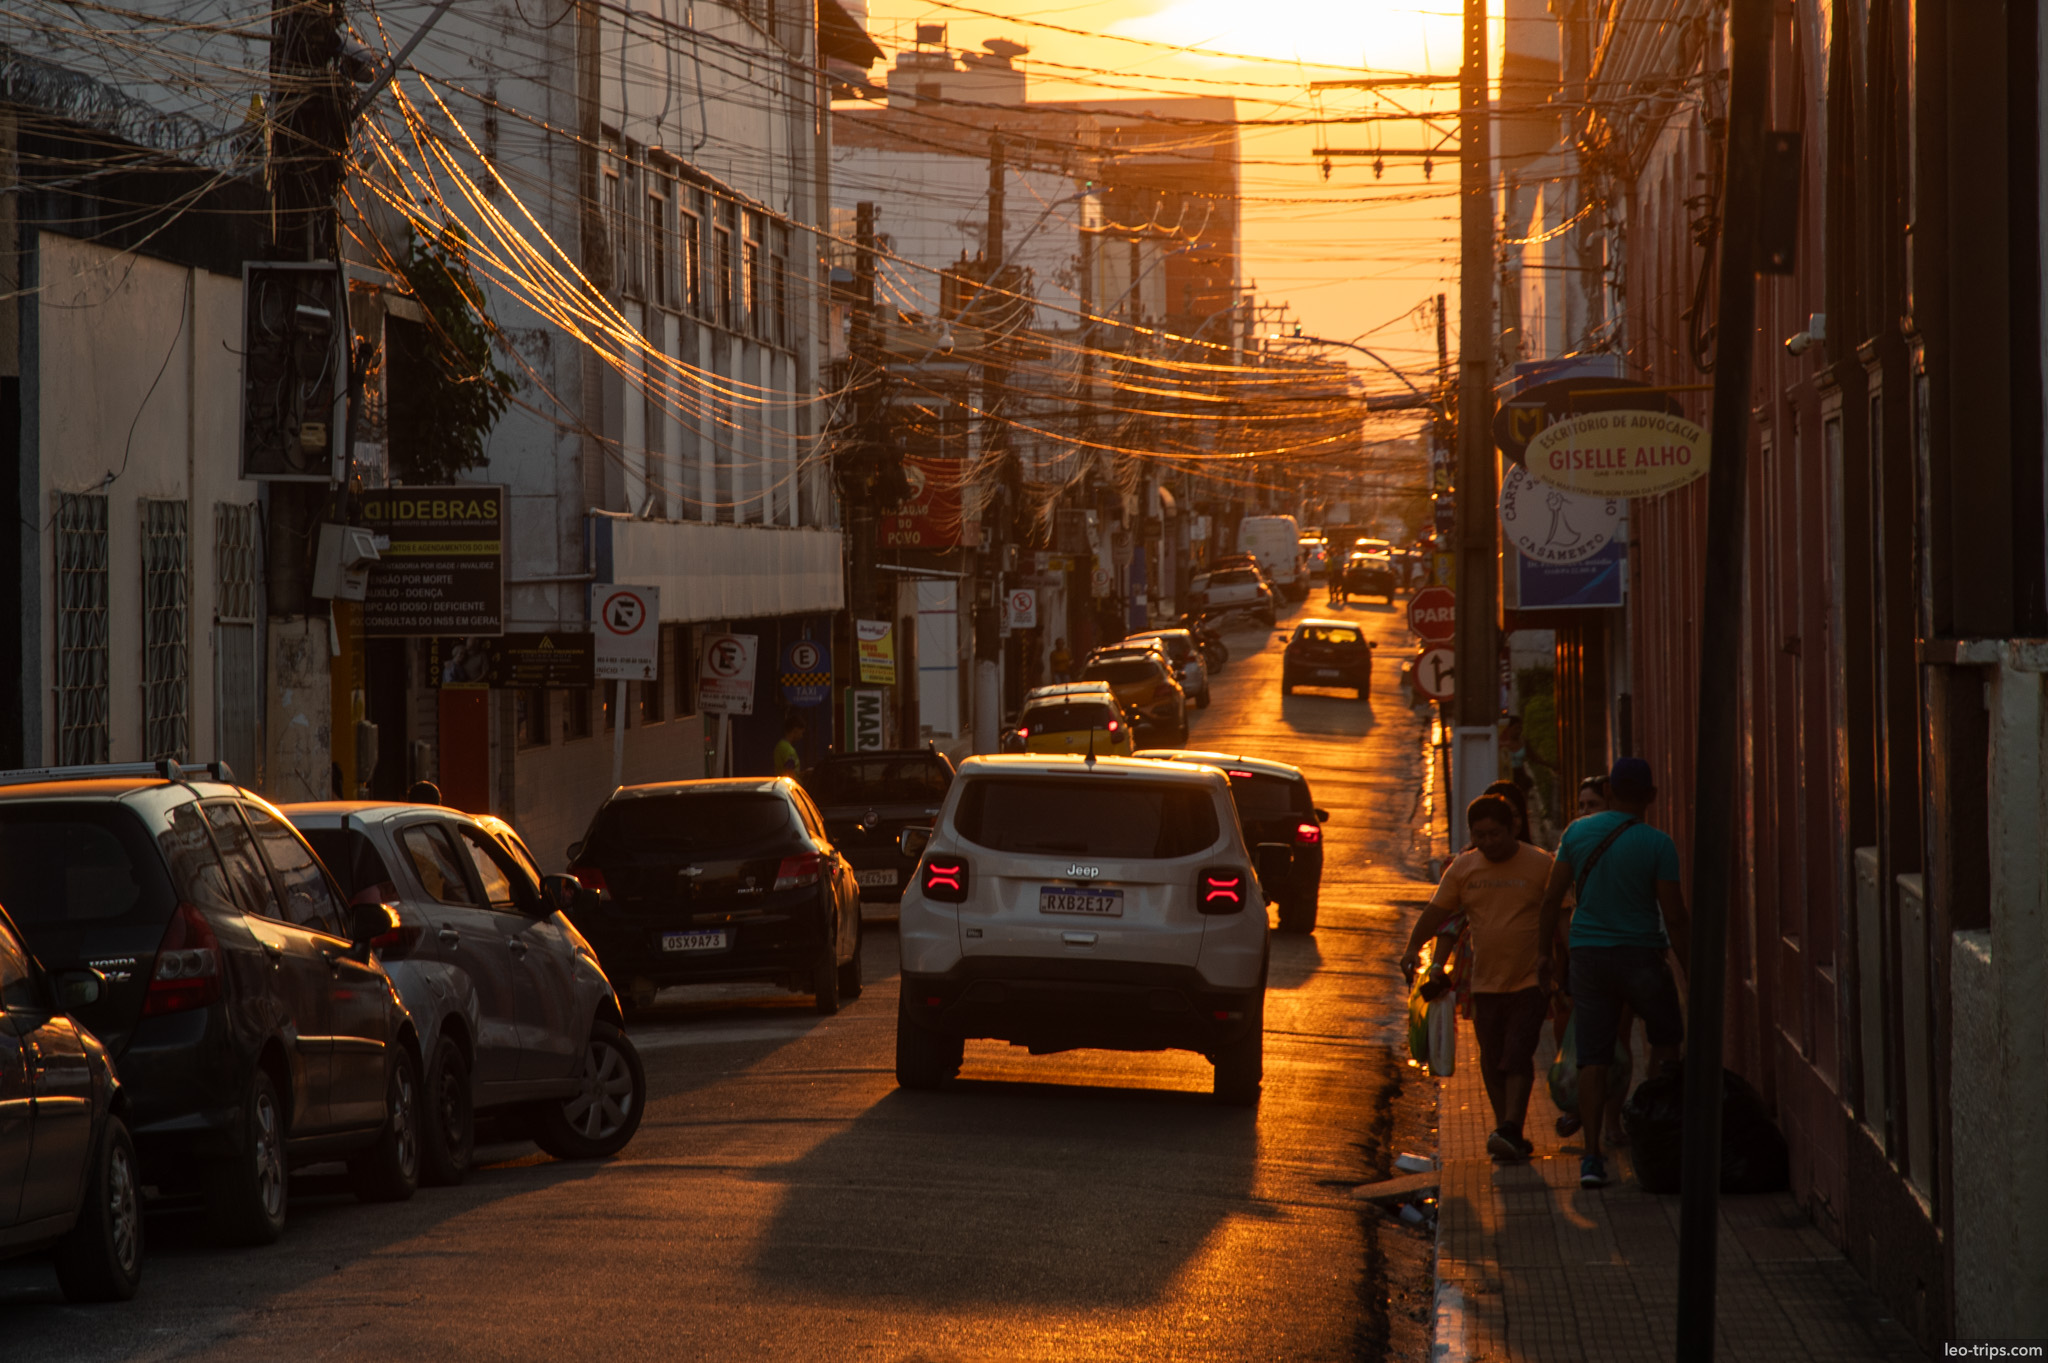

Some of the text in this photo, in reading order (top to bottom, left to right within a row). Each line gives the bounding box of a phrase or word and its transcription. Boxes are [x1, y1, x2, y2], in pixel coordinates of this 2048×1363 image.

[1613, 417, 1627, 429] DE
[1631, 416, 1700, 444] ADVOCACIA
[1549, 445, 1692, 470] GISELLE ALHO
[888, 531, 921, 545] POVO
[418, 543, 472, 552] AGENDAMENTOS
[473, 543, 483, 551] DO
[1519, 533, 1605, 561] CASAMENTO
[420, 562, 435, 570] POR
[402, 575, 421, 584] POR
[423, 574, 454, 584] MORTE
[406, 587, 443, 599] DOENÇA
[384, 602, 398, 611] AO
[399, 602, 428, 611] IDOSO
[434, 601, 485, 612] DEFICIENTE
[365, 615, 500, 626] CONSULTAS DO INSS EM GERAL
[799, 649, 809, 665] E
[796, 686, 817, 696] TAXI
[1067, 863, 1099, 878] Jeep
[1047, 895, 1114, 912] RXB2E17
[668, 935, 720, 949] OSX9A73
